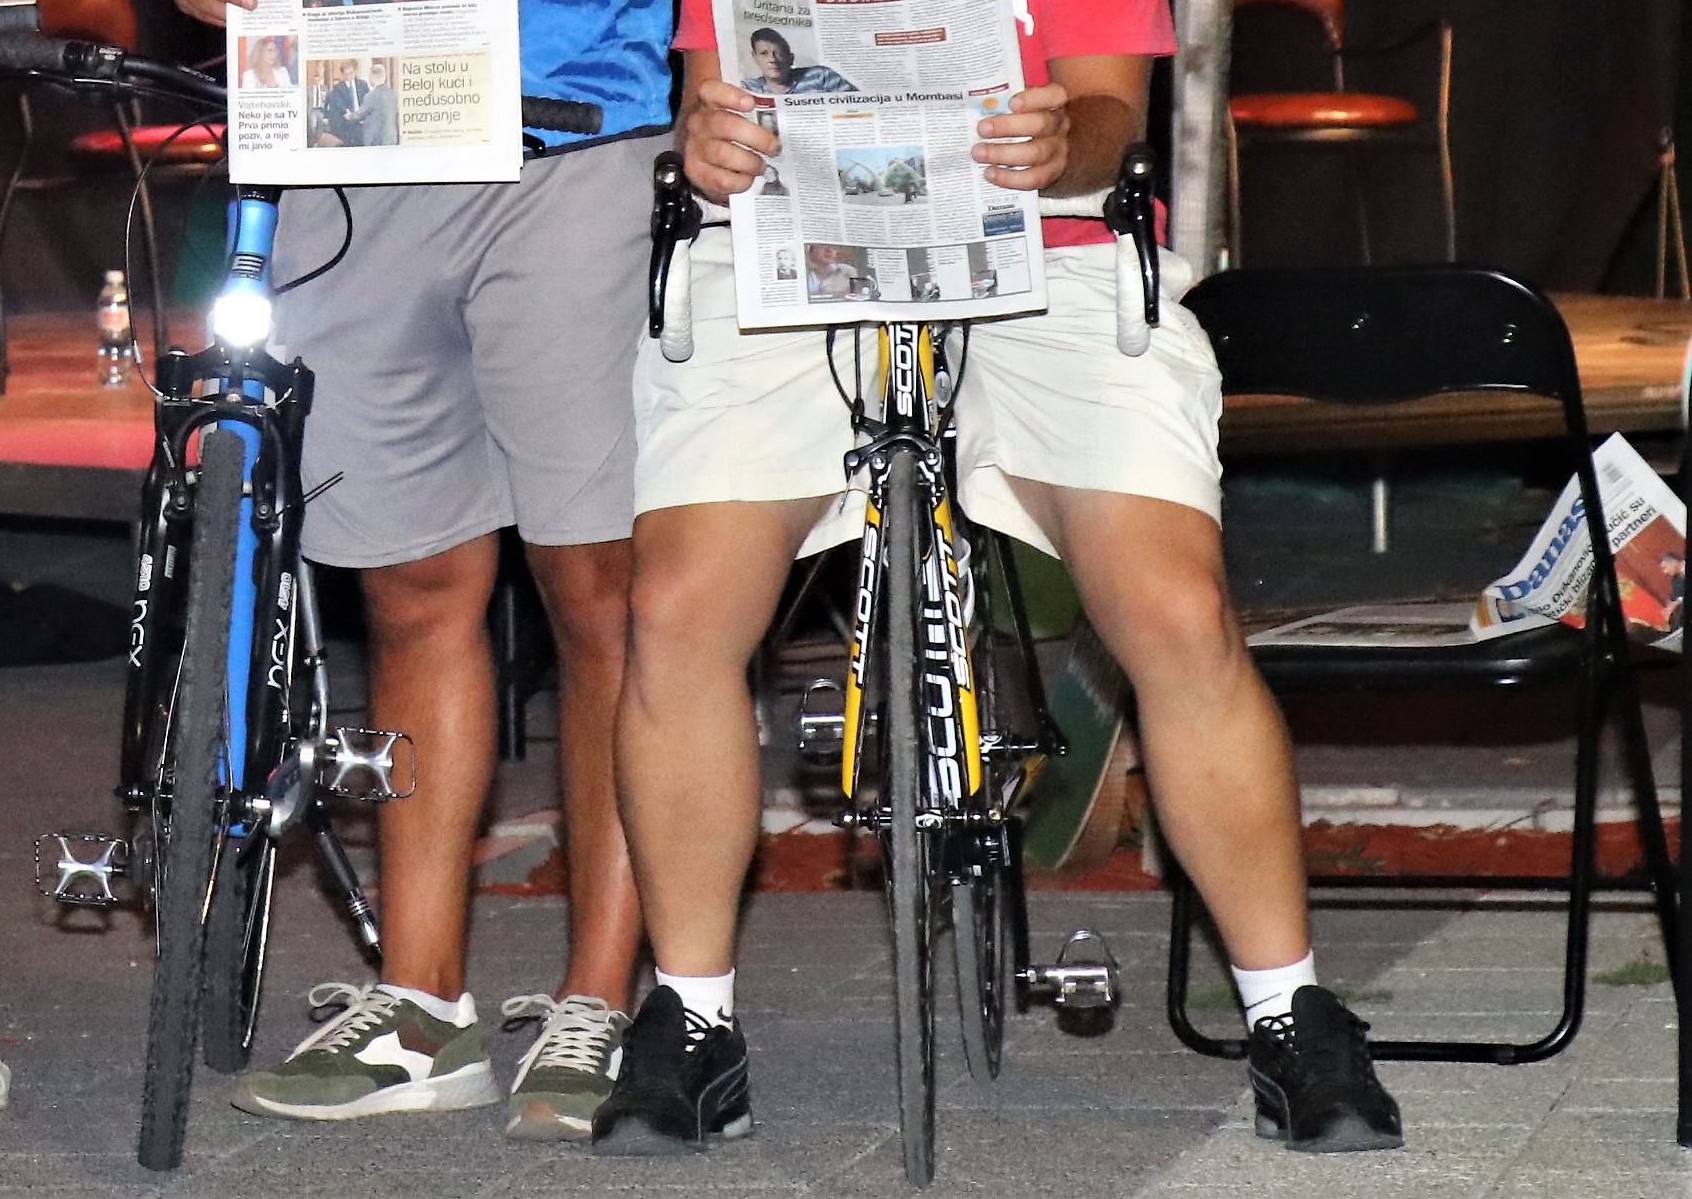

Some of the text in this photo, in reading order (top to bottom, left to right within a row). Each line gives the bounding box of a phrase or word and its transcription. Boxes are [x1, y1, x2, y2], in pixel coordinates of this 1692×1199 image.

[798, 6, 810, 15] za
[744, 11, 812, 27] predsednika
[403, 61, 468, 74] Na stolu u
[403, 75, 472, 92] Beloj kući i
[403, 92, 480, 107] međusobno
[784, 92, 963, 106] Susret civilizacija u Mombasi
[238, 111, 260, 119] Neko
[263, 111, 271, 120] je
[287, 110, 298, 118] TV
[403, 108, 460, 126] priznanje
[261, 122, 288, 130] primio
[239, 132, 262, 142] poziv,
[274, 132, 289, 141] nije
[239, 142, 272, 151] mi javio
[896, 325, 912, 417] SCOT
[1629, 496, 1646, 512] su
[1611, 506, 1657, 547] partneri
[1495, 497, 1586, 602] Danas
[138, 553, 153, 592] 450
[277, 572, 292, 611] 450
[853, 524, 877, 684] SCOTT
[936, 528, 970, 690] SCOTT
